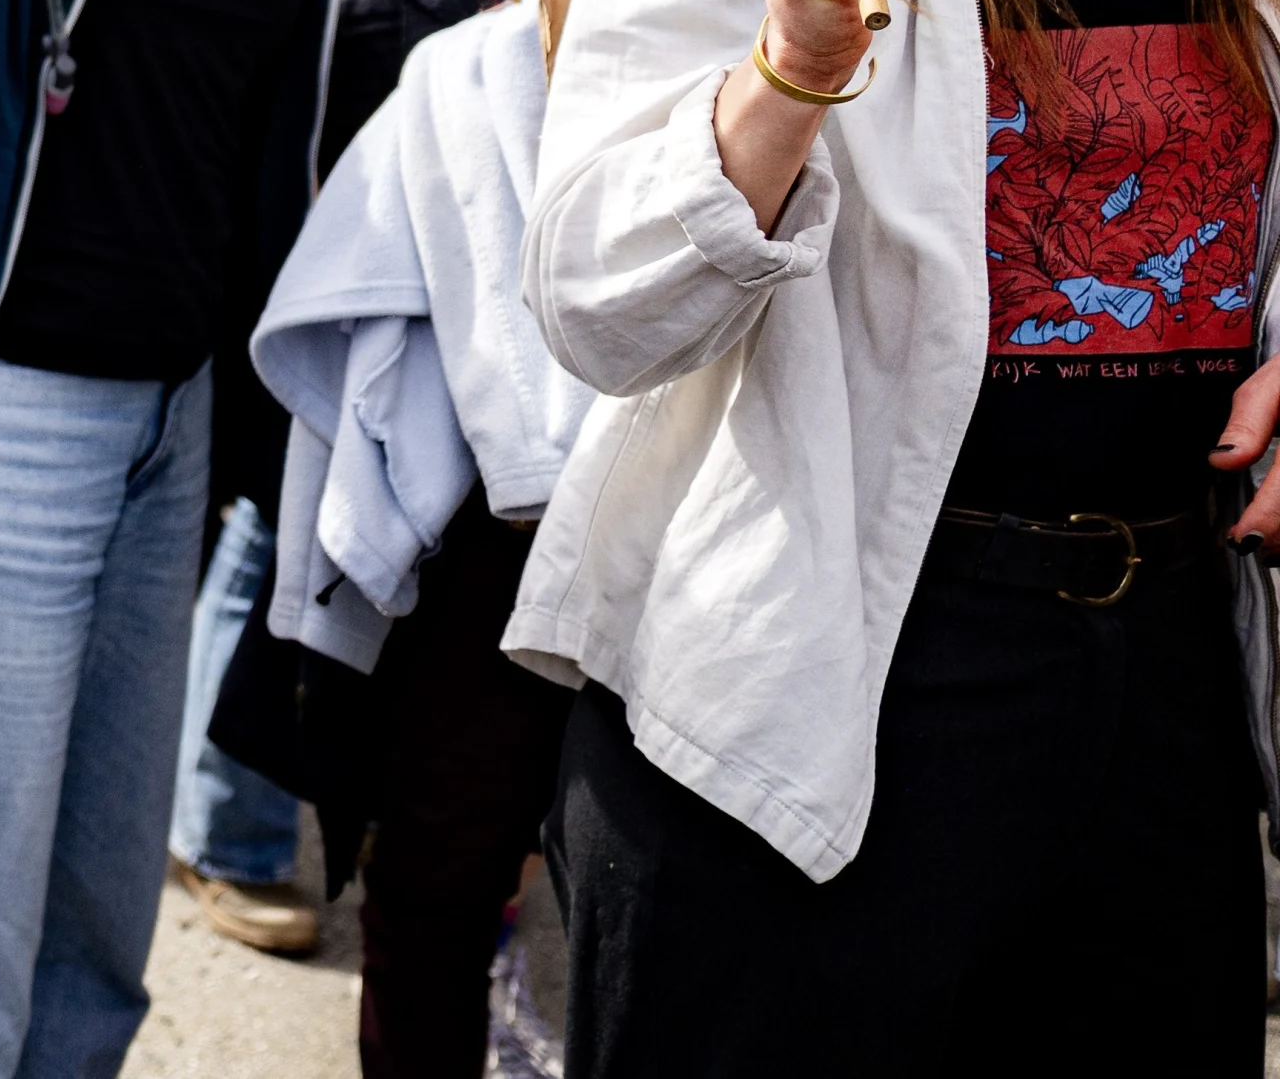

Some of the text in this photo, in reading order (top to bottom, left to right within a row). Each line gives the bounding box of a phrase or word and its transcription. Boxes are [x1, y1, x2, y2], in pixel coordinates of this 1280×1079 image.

[991, 360, 1041, 383] KIJK
[1057, 362, 1091, 379] WAT
[1100, 362, 1138, 378] EEN
